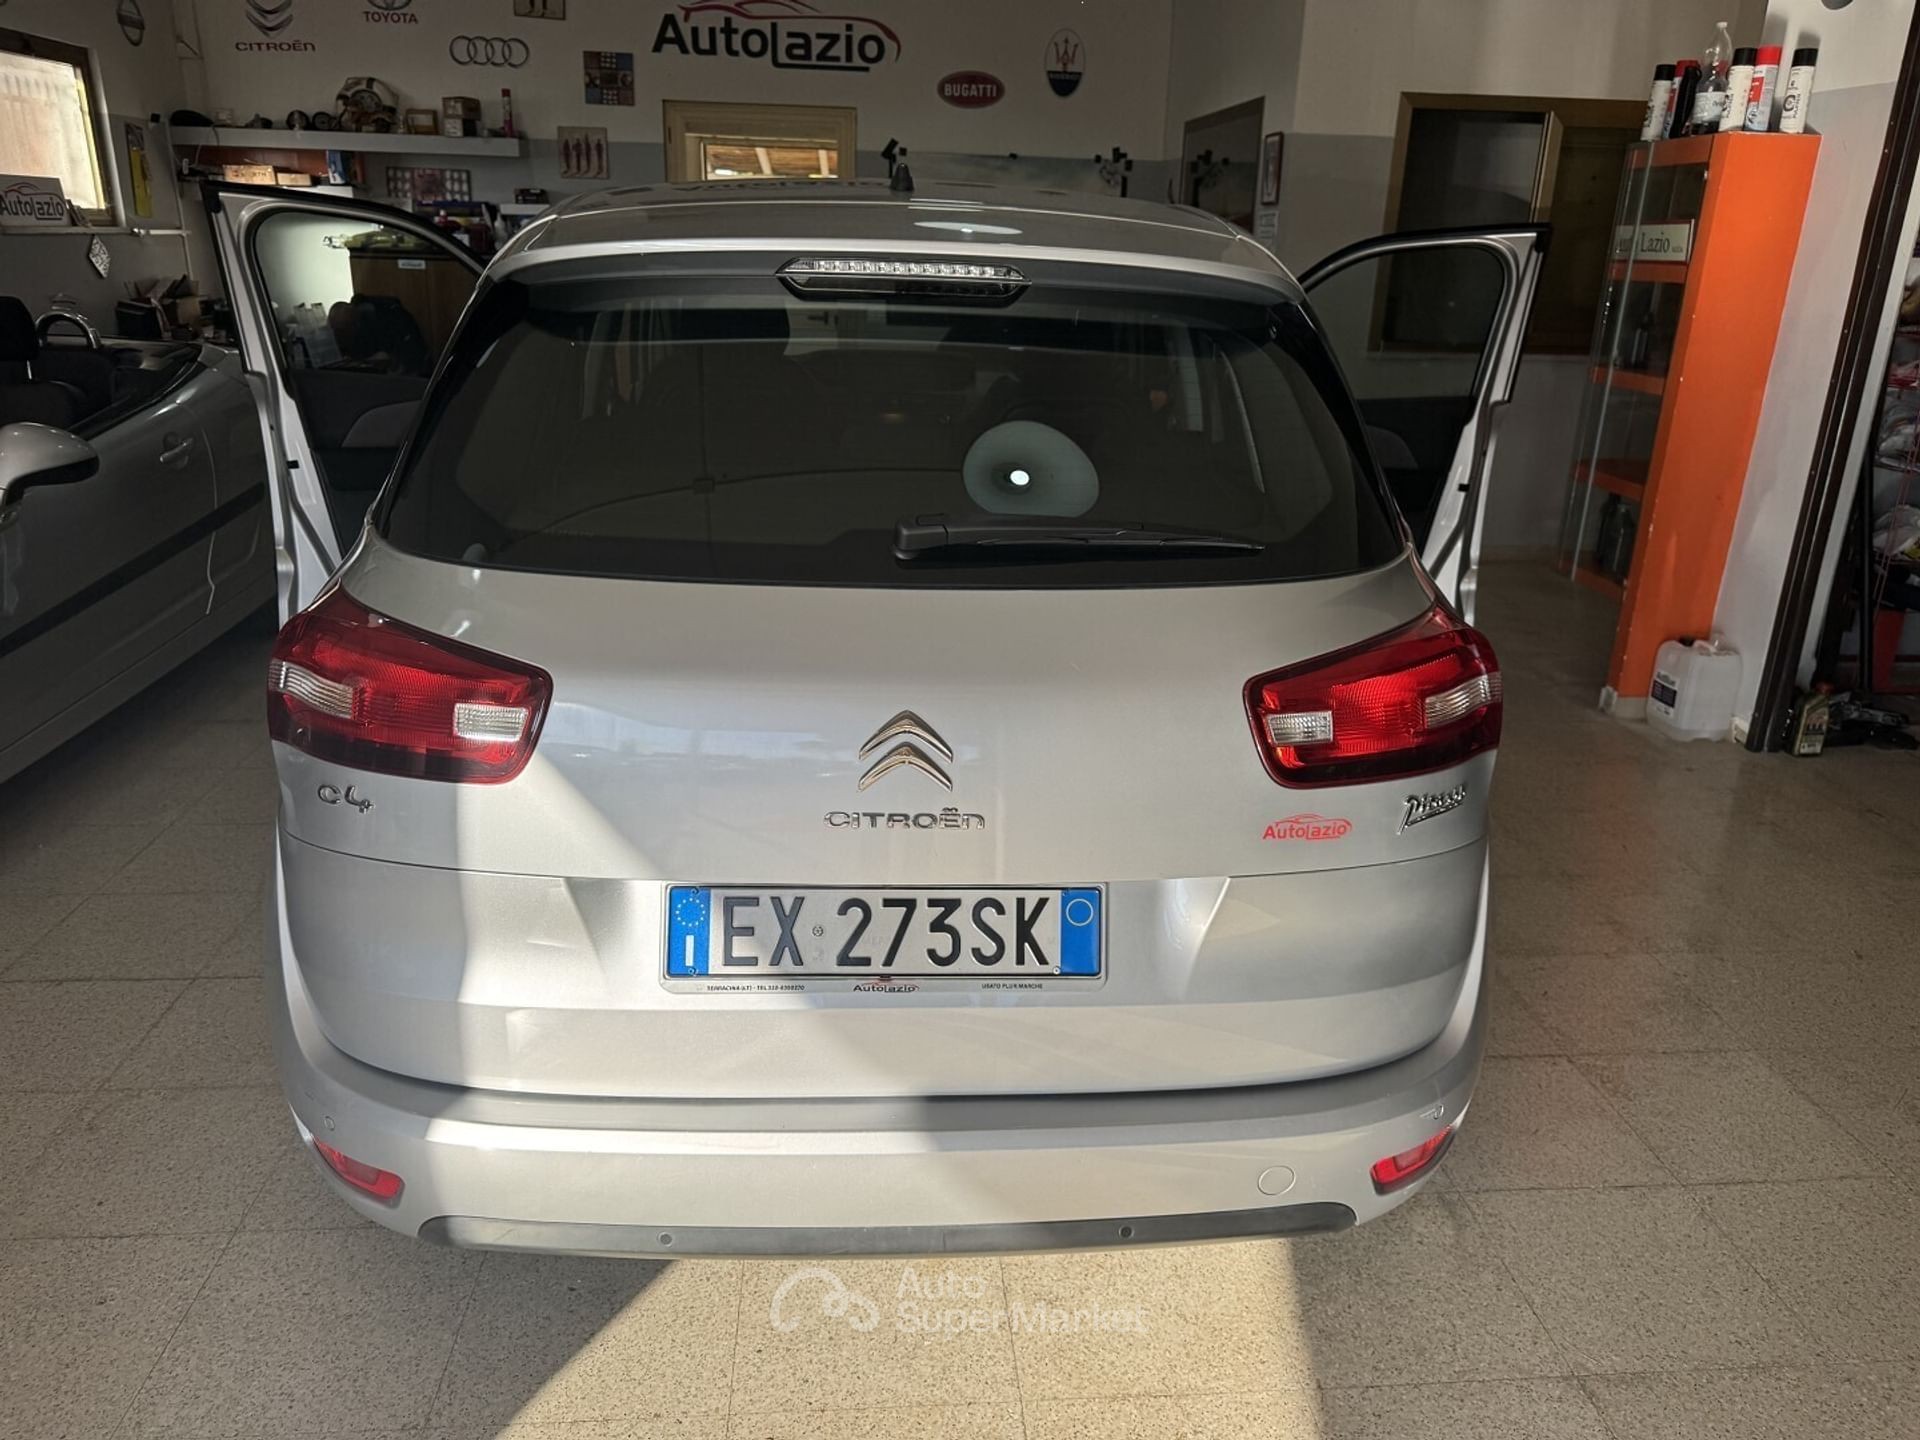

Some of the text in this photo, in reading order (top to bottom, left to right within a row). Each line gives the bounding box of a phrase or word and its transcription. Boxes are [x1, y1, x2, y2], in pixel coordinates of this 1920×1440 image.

[363, 11, 418, 24] TOYOTA
[944, 83, 997, 97] BUGATTI
[1641, 231, 1671, 253] Lazio
[317, 784, 375, 815] C4
[722, 896, 1051, 968] EX 273SK
